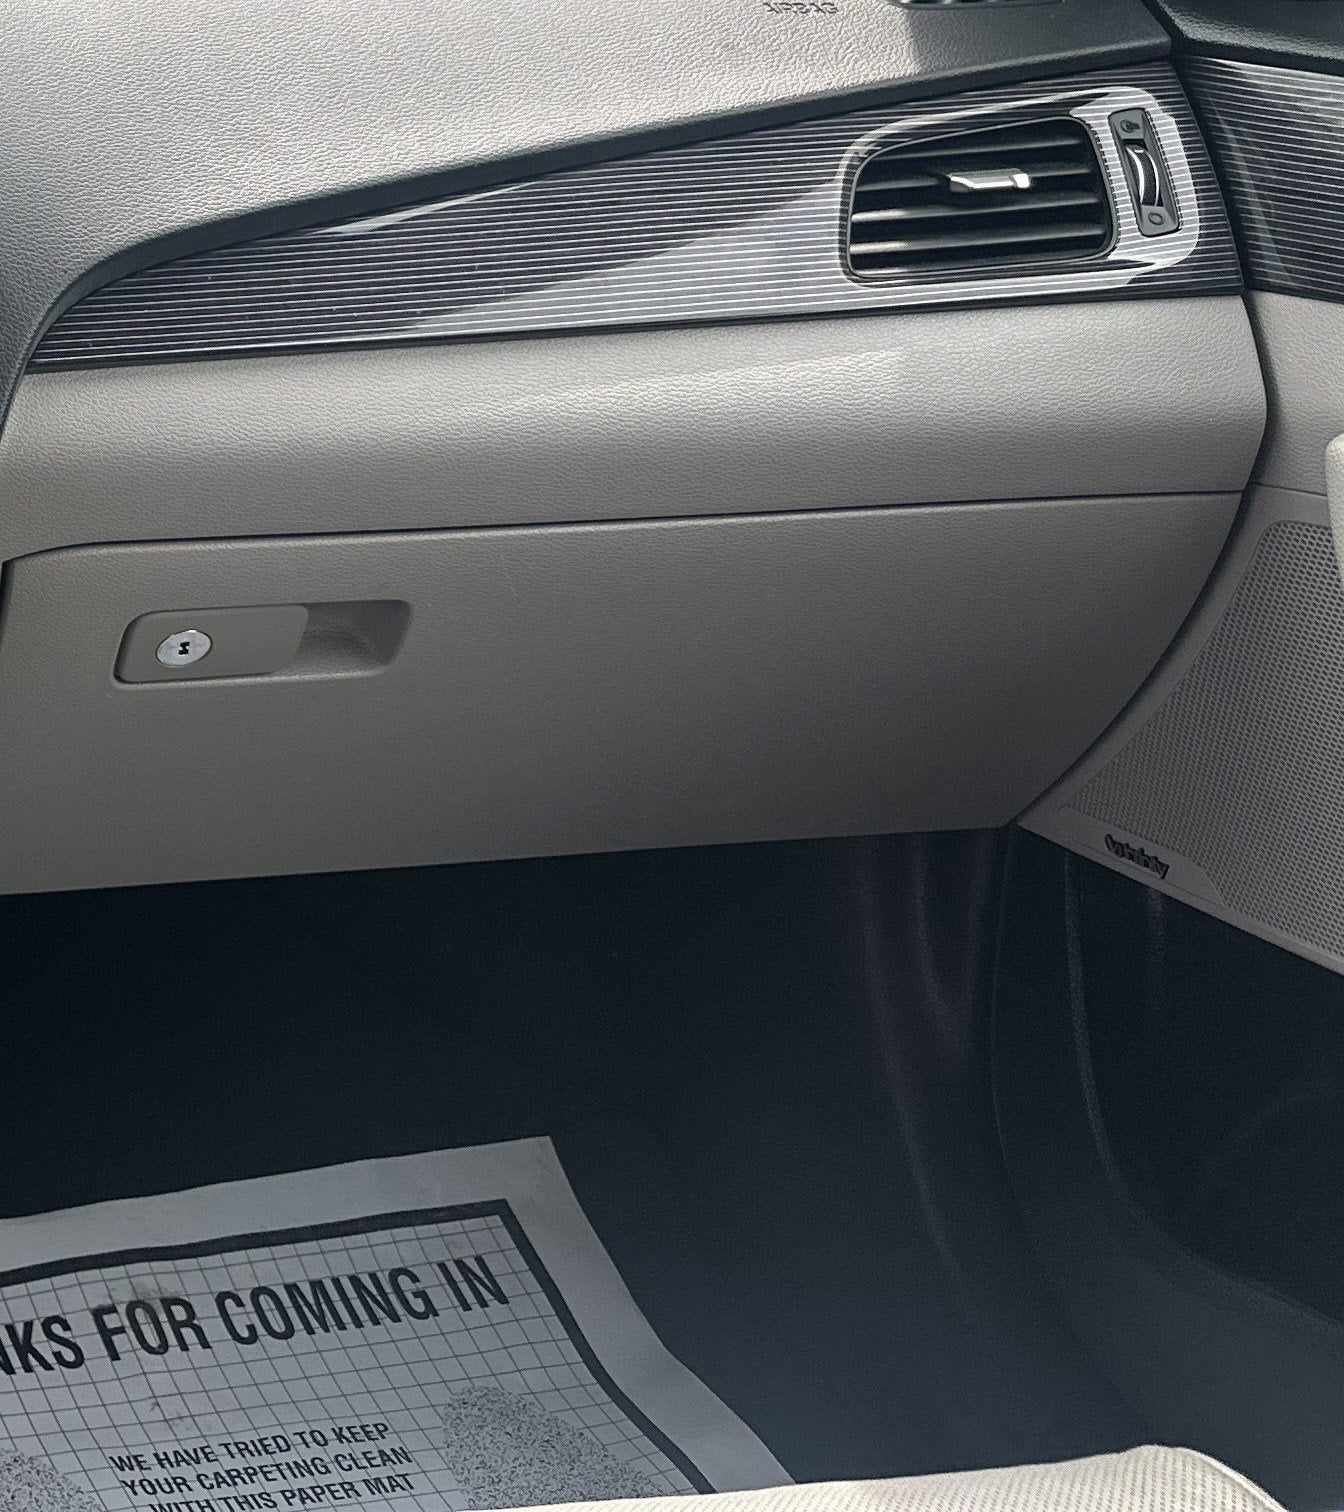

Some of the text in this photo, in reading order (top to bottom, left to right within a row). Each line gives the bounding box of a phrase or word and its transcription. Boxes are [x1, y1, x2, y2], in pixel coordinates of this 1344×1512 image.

[762, 1, 839, 15] AIRBAG
[91, 1296, 212, 1362] FOR
[214, 1266, 439, 1346] COMING
[436, 1255, 511, 1313] IN
[109, 1422, 390, 1473] WE HAVE TRIED TO KEEP
[119, 1445, 415, 1497] YOUR CARPETING CLEAN
[216, 1492, 279, 1512] THIS
[280, 1480, 362, 1507] PAPER
[361, 1472, 416, 1496] MAT
